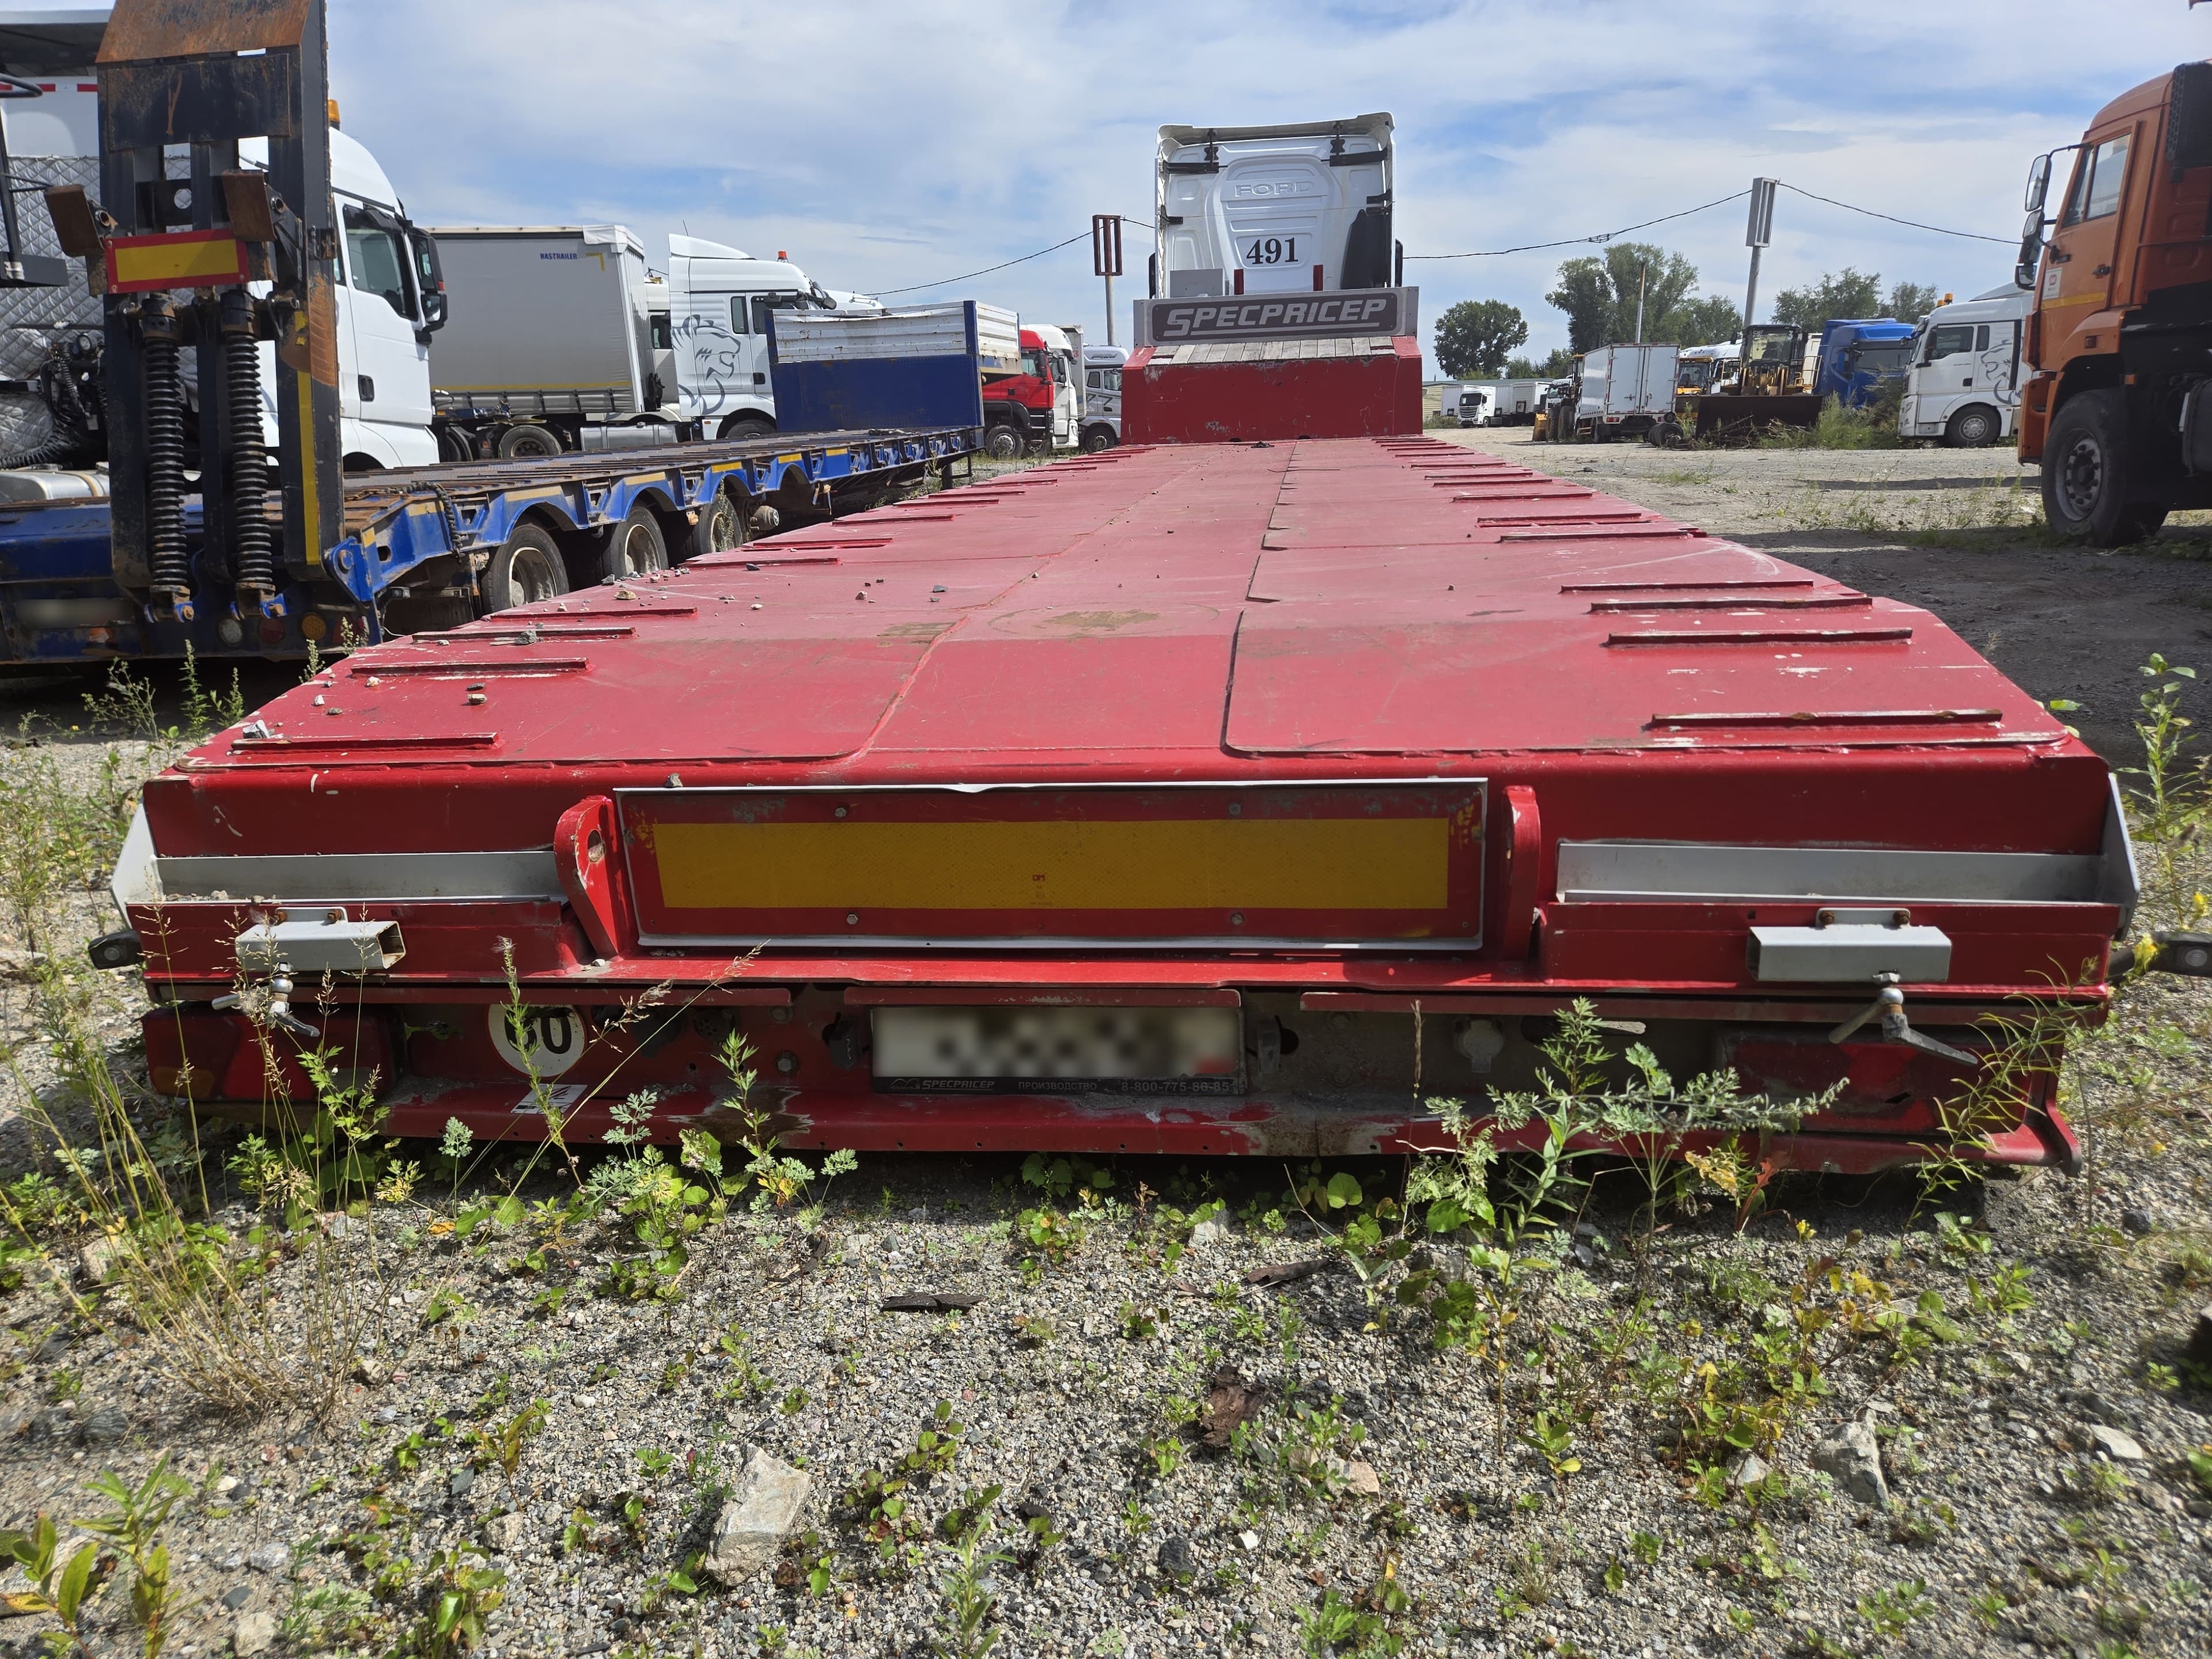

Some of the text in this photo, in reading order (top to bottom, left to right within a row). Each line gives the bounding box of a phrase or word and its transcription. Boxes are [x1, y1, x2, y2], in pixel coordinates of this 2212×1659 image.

[1235, 181, 1314, 197] FORD
[1246, 237, 1298, 265] 491
[1164, 298, 1387, 336] SPECPRICEP
[922, 1080, 995, 1090] SPECPRICEP
[1018, 1081, 1097, 1090] ПРОИЗВОДСТВО
